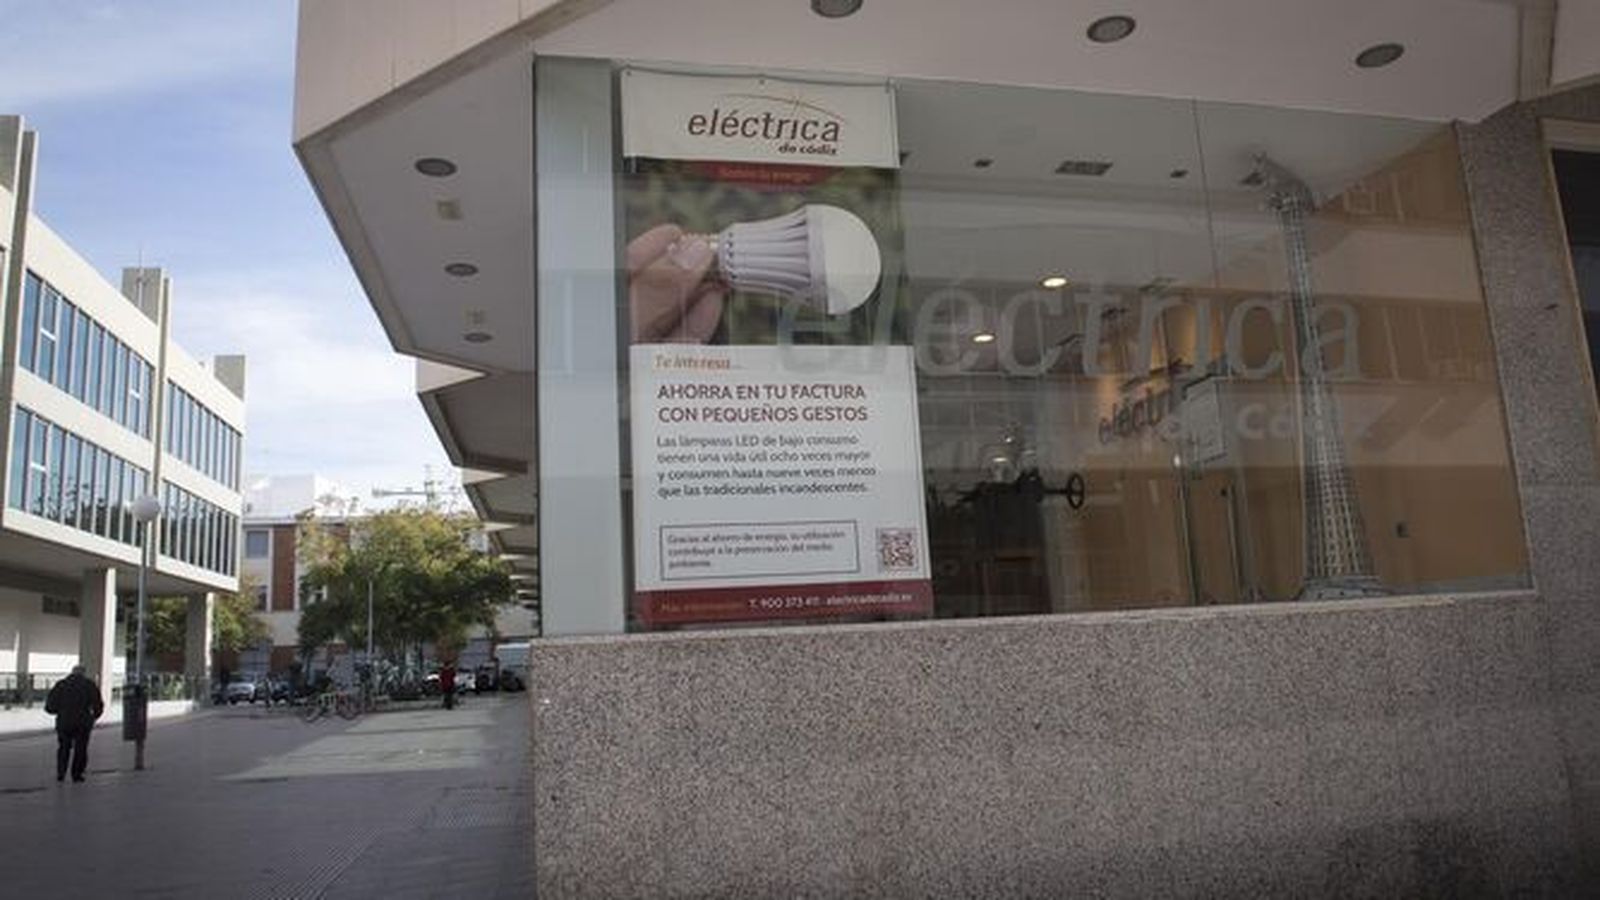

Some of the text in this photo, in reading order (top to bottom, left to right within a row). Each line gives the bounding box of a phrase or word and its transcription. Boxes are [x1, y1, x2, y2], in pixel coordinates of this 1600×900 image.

[687, 108, 841, 142] eléctrica
[778, 143, 797, 154] de
[658, 384, 866, 400] AHORRA EN TU FACTURA
[658, 403, 868, 423] CON PEQUEÑOS GESTOS
[656, 434, 860, 450] Las lámparas LED de bajo consumo
[657, 450, 871, 464] tienen una vida útil ocho veces mayor
[657, 466, 876, 484] y consumen hasta nueve veces menos
[657, 481, 868, 499] que las tradicionales incandescentes.
